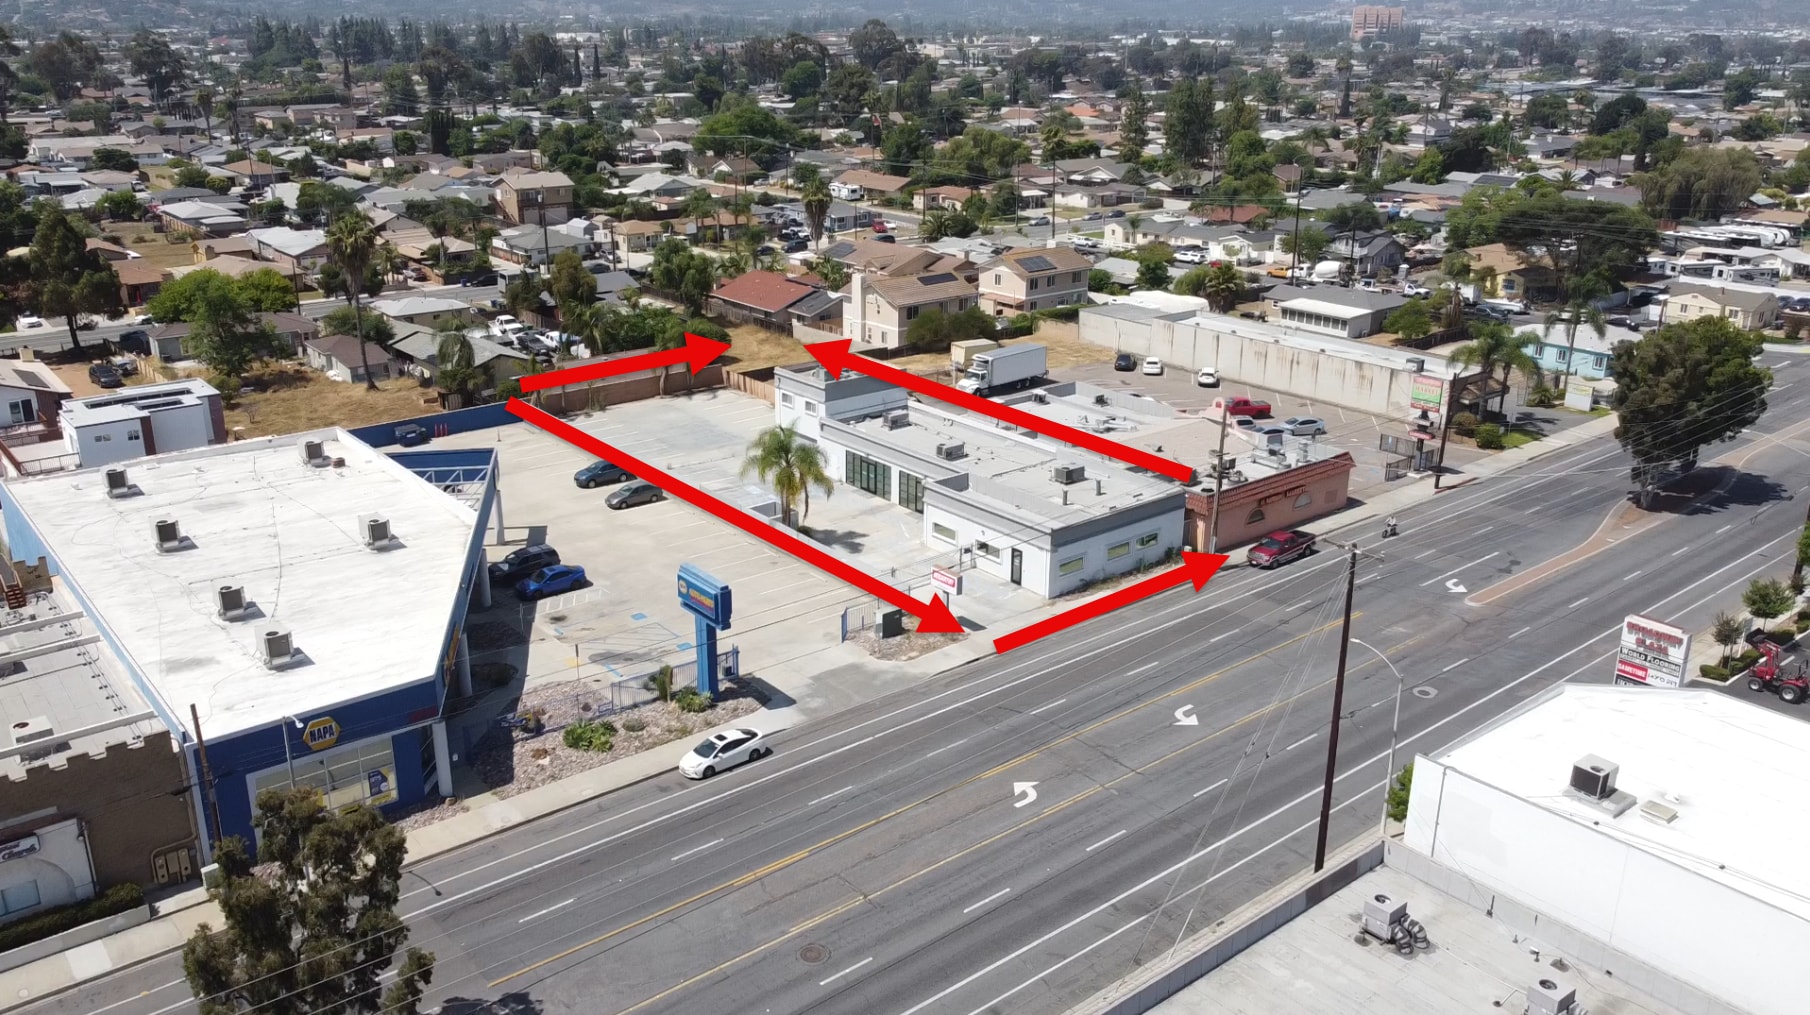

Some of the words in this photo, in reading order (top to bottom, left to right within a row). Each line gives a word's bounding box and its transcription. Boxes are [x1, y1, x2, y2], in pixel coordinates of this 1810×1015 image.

[1621, 647, 1646, 660] WORLD
[1646, 653, 1680, 671] FLOORING
[308, 723, 335, 744] NAPA
